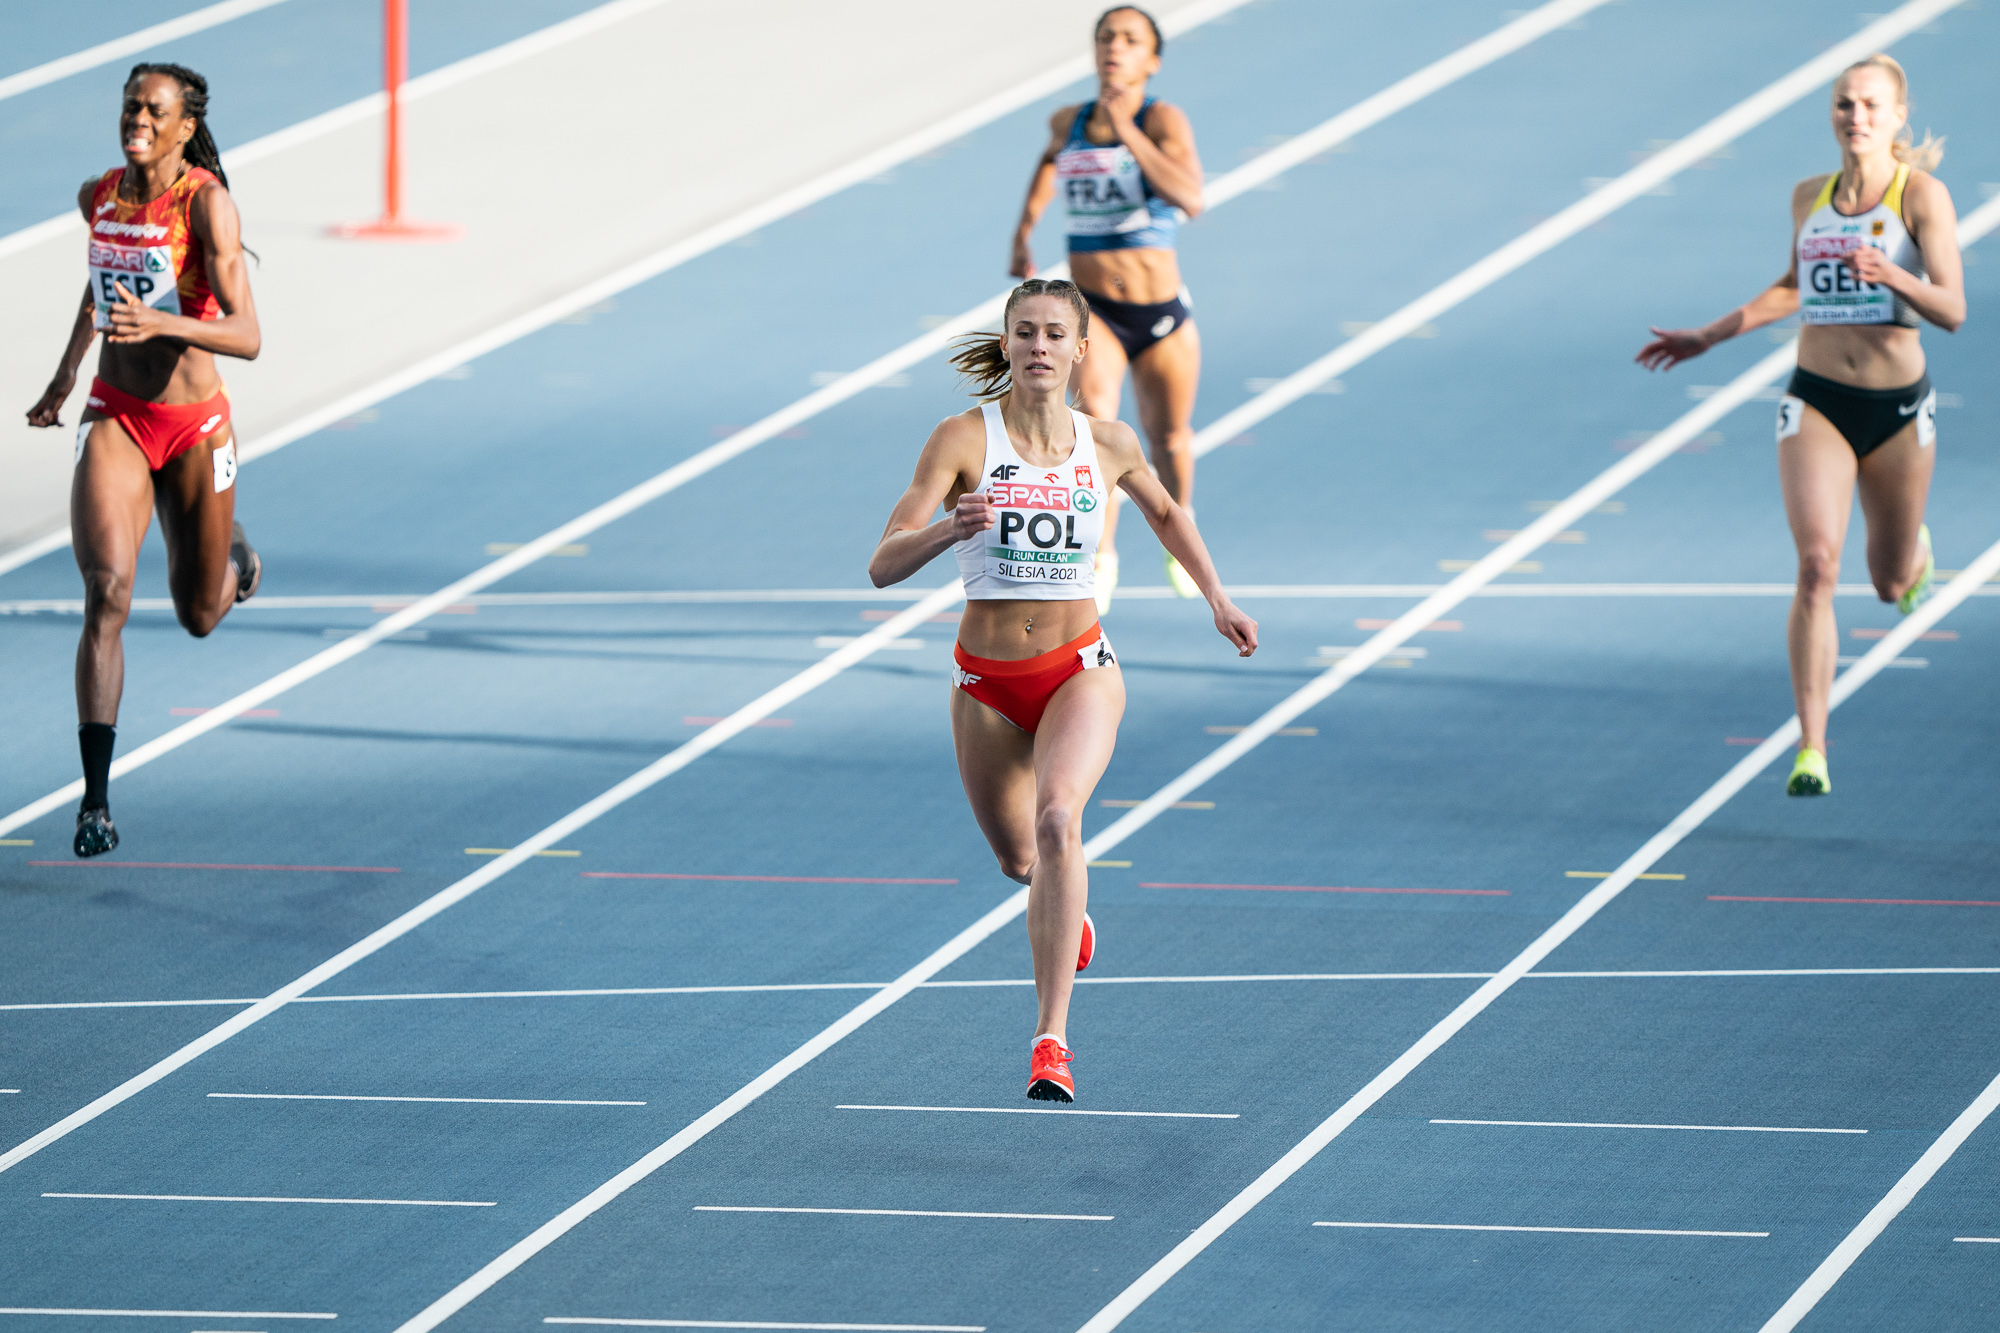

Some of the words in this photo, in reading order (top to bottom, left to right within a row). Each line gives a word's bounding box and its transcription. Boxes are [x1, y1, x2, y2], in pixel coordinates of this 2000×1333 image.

[1066, 178, 1128, 204] FRA
[90, 246, 142, 270] SPAR
[100, 271, 154, 303] ESP
[990, 464, 1020, 480] 4F
[992, 485, 1068, 508] SPAR
[1000, 511, 1083, 549] POL
[1007, 550, 1011, 559] I
[1012, 551, 1036, 561] RUN
[1037, 552, 1069, 563] CLEAN
[998, 562, 1046, 579] SILESIA
[1050, 567, 1077, 580] 2021
